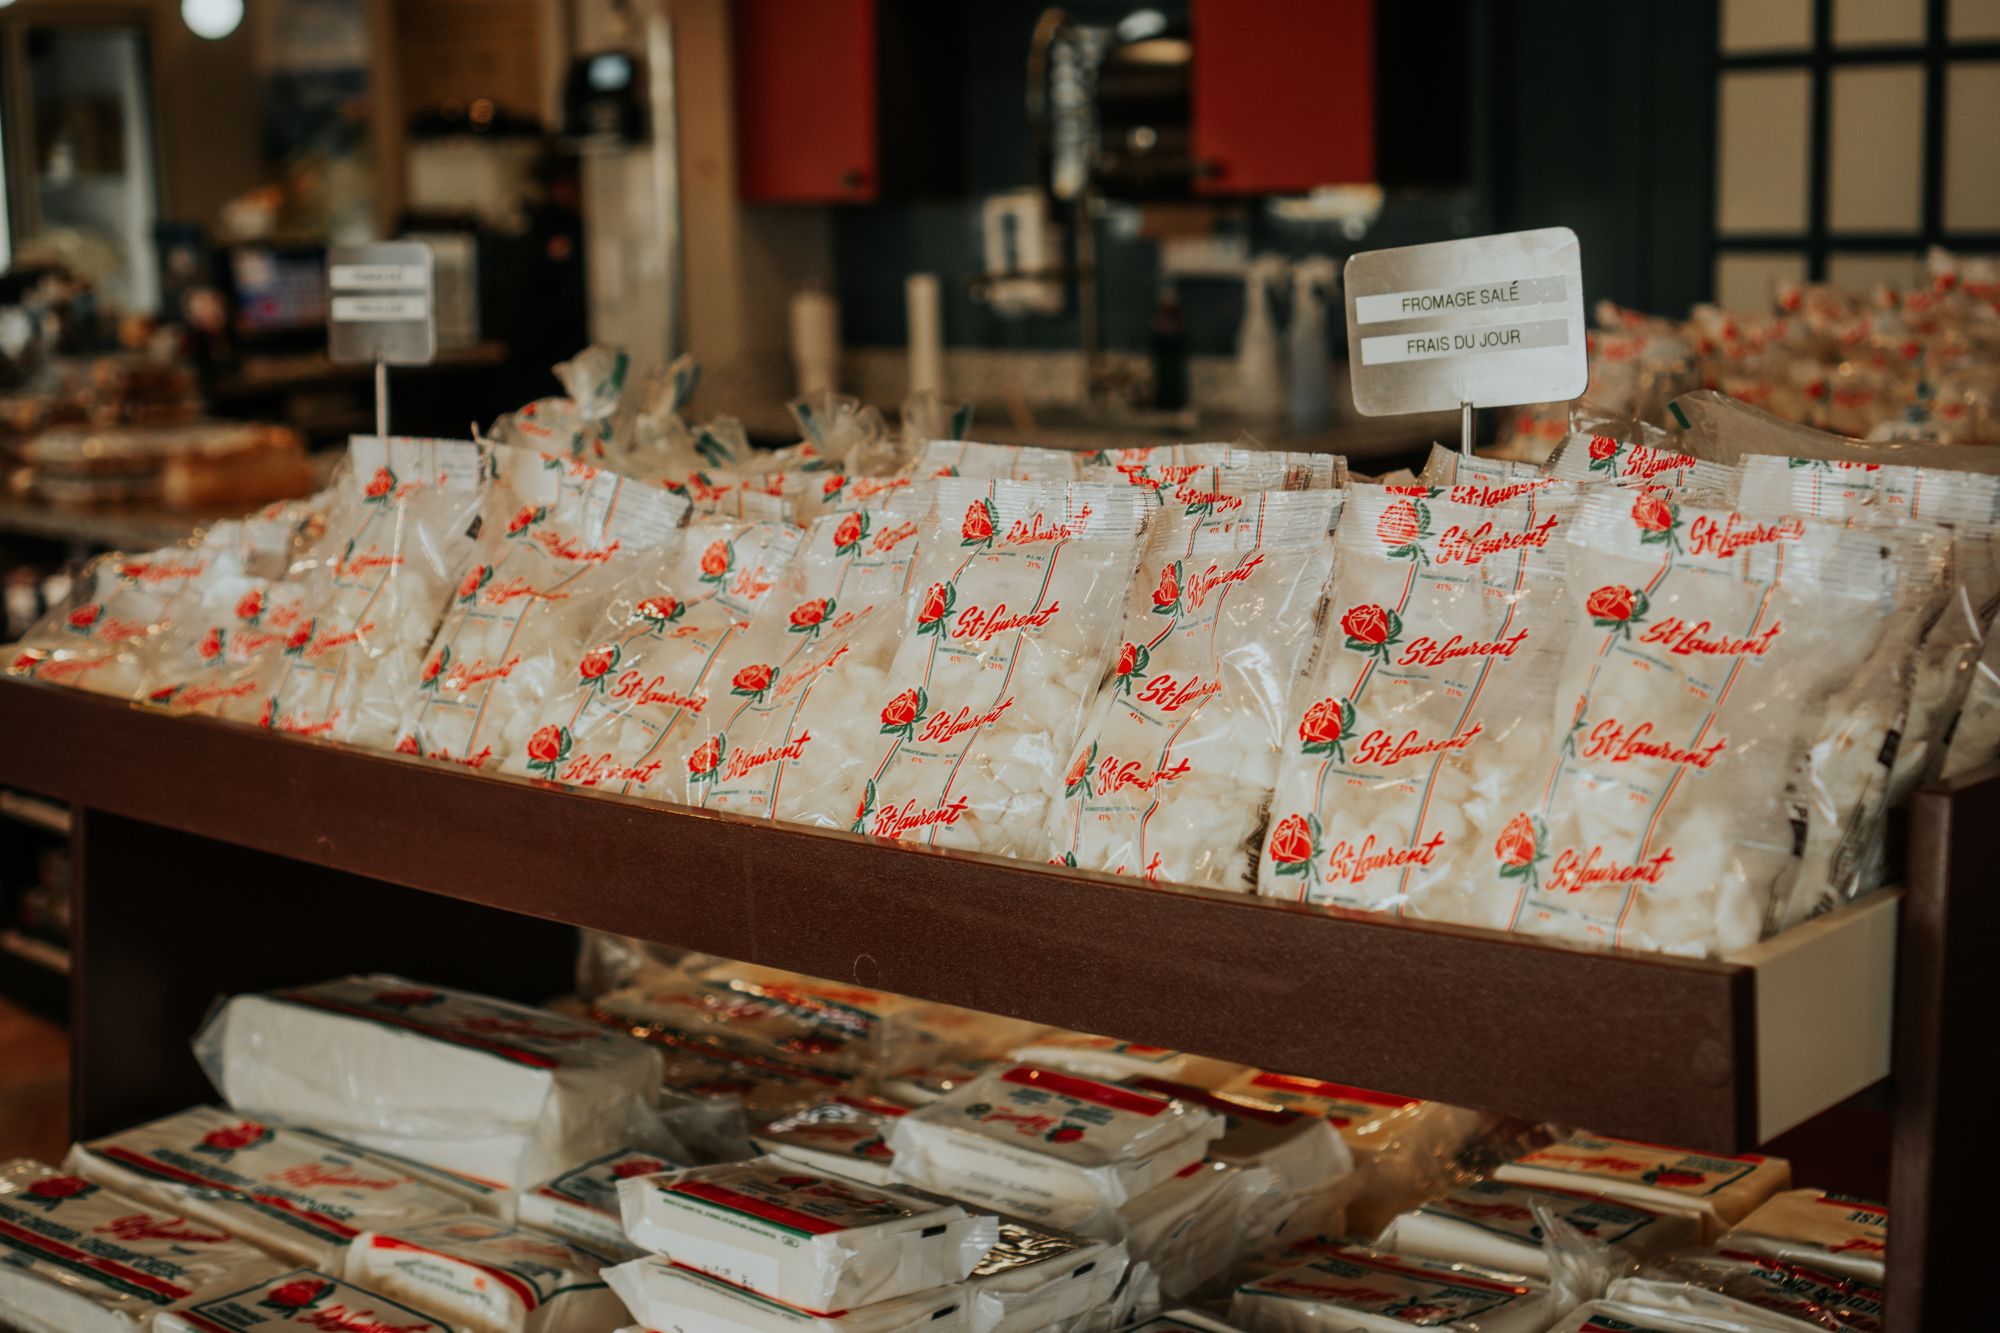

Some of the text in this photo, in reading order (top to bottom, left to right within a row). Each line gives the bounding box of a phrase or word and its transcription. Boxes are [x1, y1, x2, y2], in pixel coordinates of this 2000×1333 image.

[1402, 280, 1519, 312] FROMAGE SALÉ
[1407, 330, 1521, 354] FRAIS DU JOUR
[952, 600, 1060, 641] St-Laurent
[1639, 616, 1783, 656] St-Laurent
[1398, 627, 1529, 667] St-Laurent
[918, 695, 1015, 744] St-Laurent
[722, 729, 812, 782] St-Laurent
[1352, 721, 1483, 766] St-Laurent
[1583, 718, 1728, 769] St-Laurent
[1326, 831, 1446, 884] St-Laurent
[1545, 845, 1676, 894] St-Laurent
